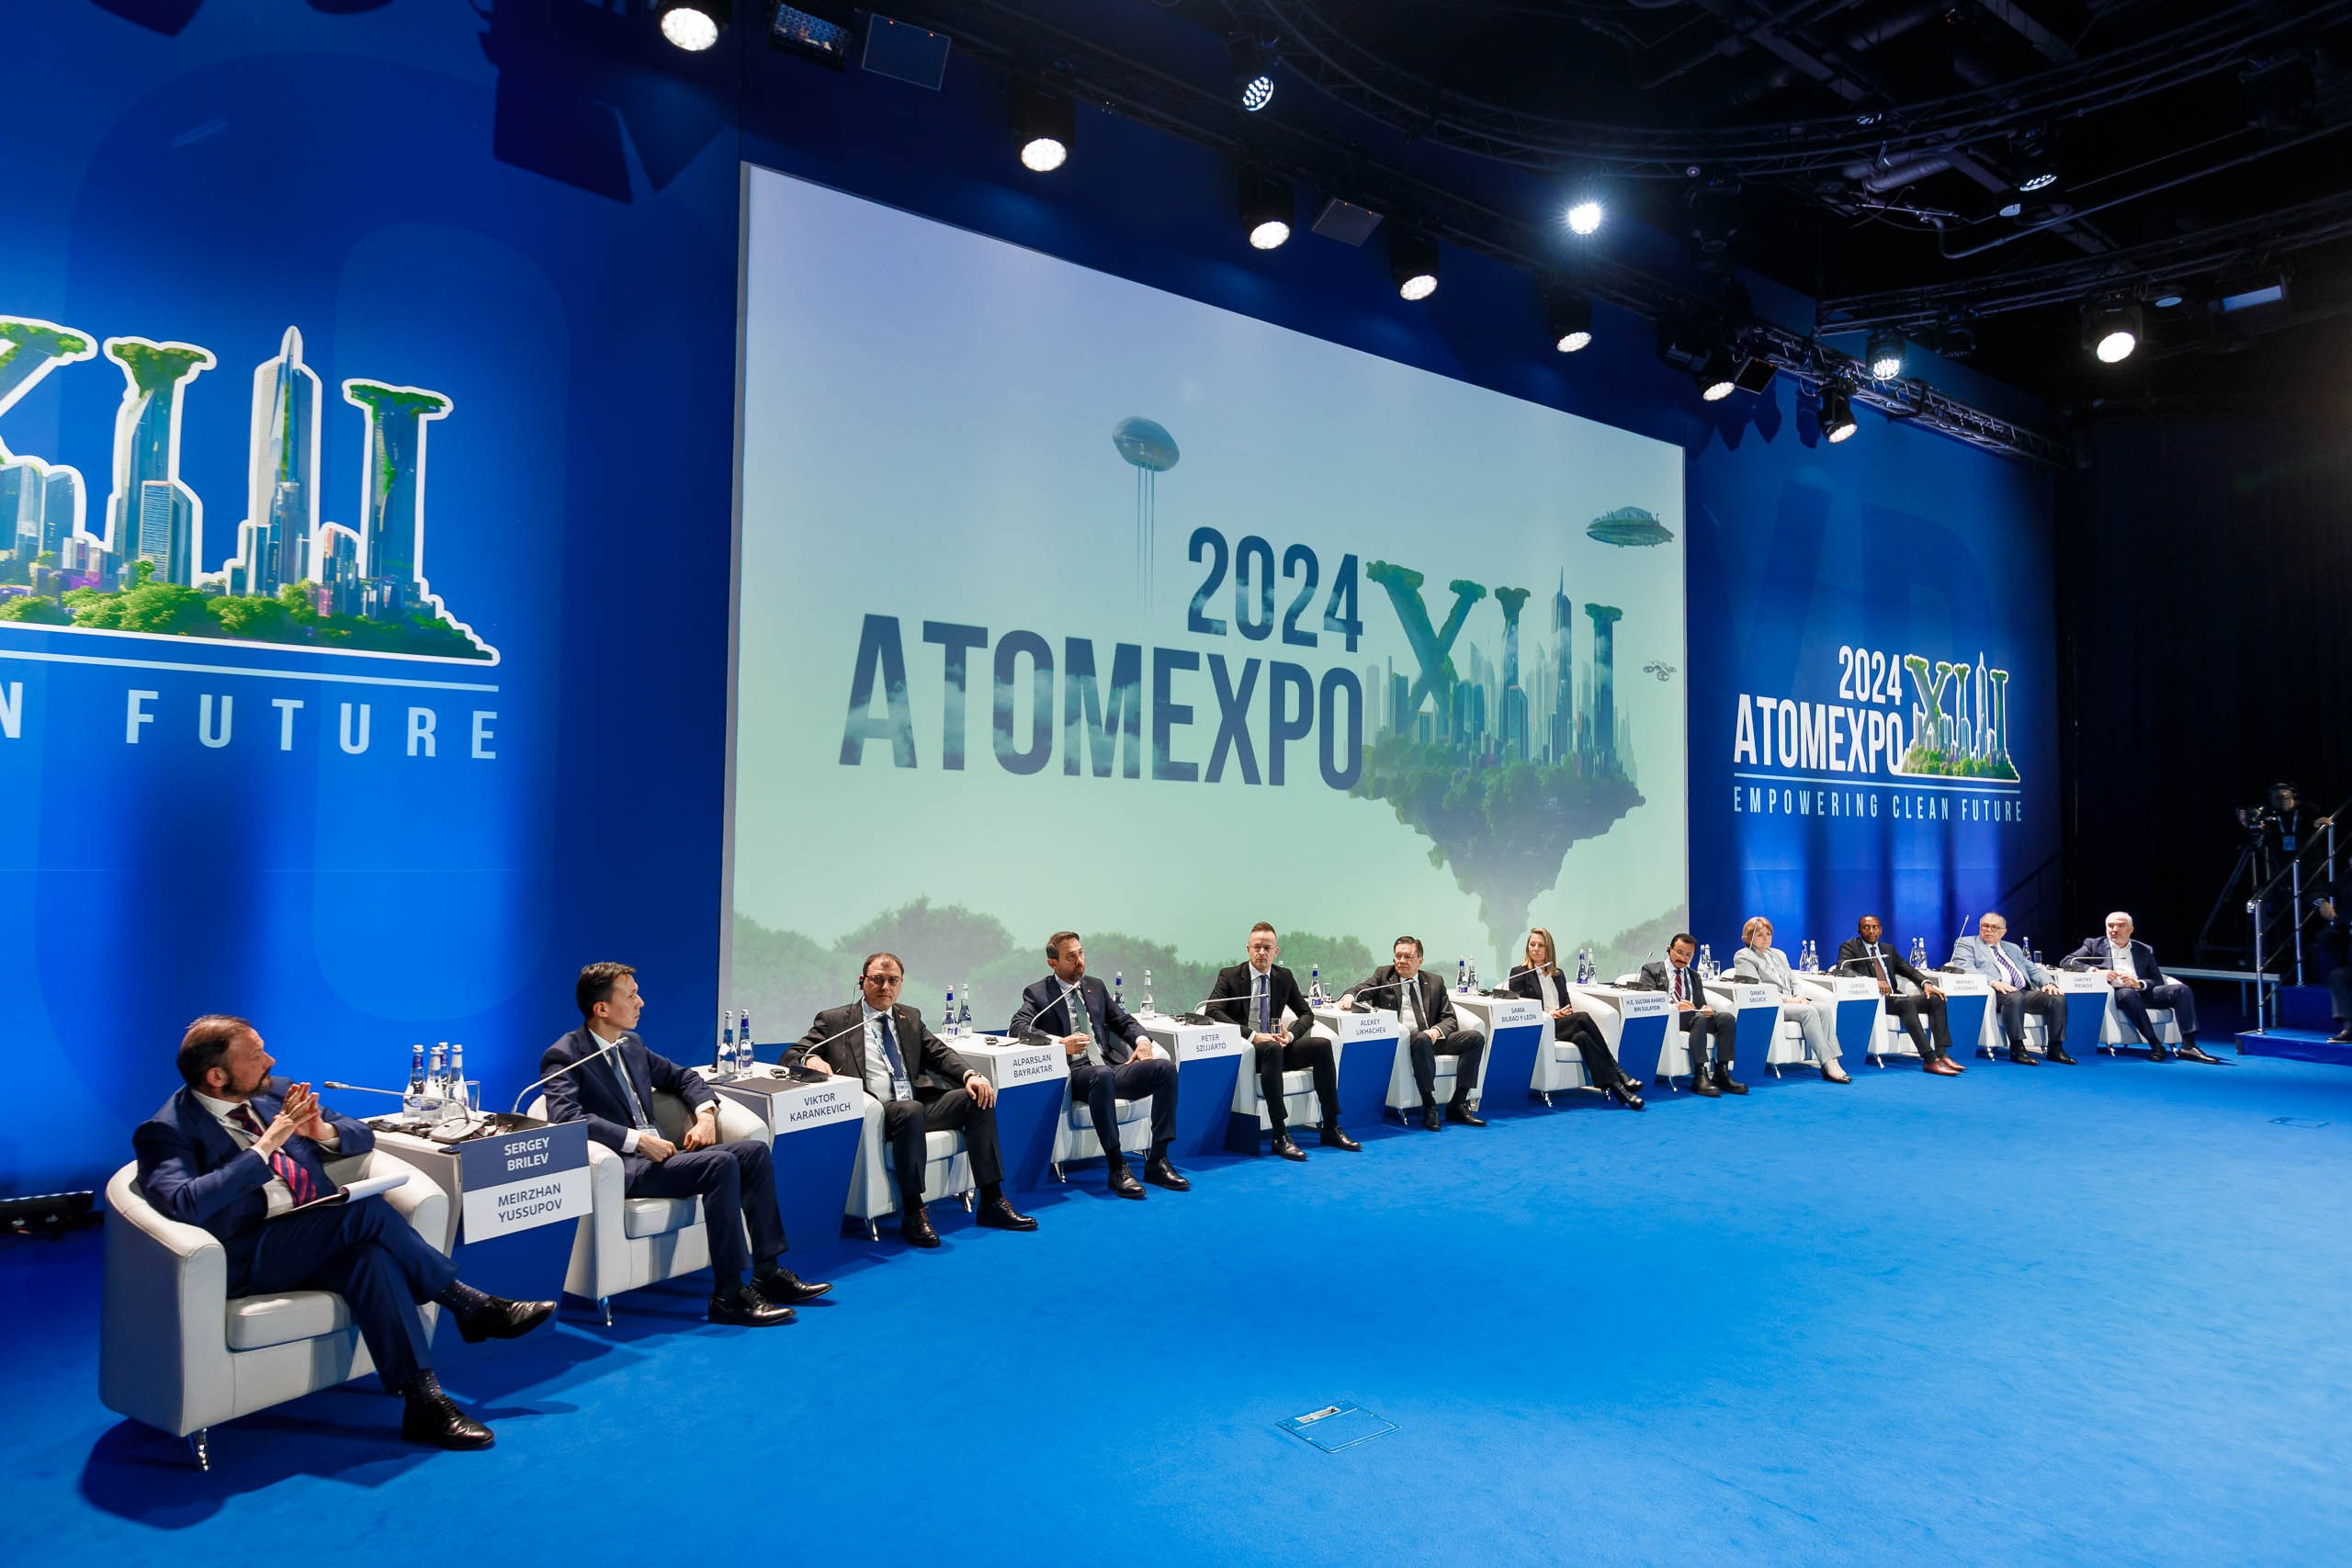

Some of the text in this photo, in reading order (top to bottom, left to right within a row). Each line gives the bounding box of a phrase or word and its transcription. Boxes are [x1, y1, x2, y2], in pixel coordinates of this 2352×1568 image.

[1188, 526, 1363, 653] 2024
[1838, 645, 1903, 706] 2024
[839, 613, 1363, 791] ATOMEXPO
[125, 688, 499, 760] FUTURE
[1734, 693, 1905, 775] ATOMEXPO
[1734, 785, 2022, 822] EMPOWERING CLEAN FUTURE
[1355, 1026, 1386, 1036] LIKHACHEV
[1360, 1018, 1381, 1027] ALEXEY
[1012, 1054, 1052, 1067] ALPARSLAN
[1013, 1064, 1053, 1078] BAYRAKTAR
[804, 1092, 836, 1107] VIKTOR
[789, 1101, 851, 1122] KARANKEVICH
[503, 1136, 550, 1156] SERGEY
[506, 1152, 549, 1171] BRILEV
[498, 1182, 561, 1208] MEIRZHAN
[498, 1198, 562, 1224] YUSSUPOV
